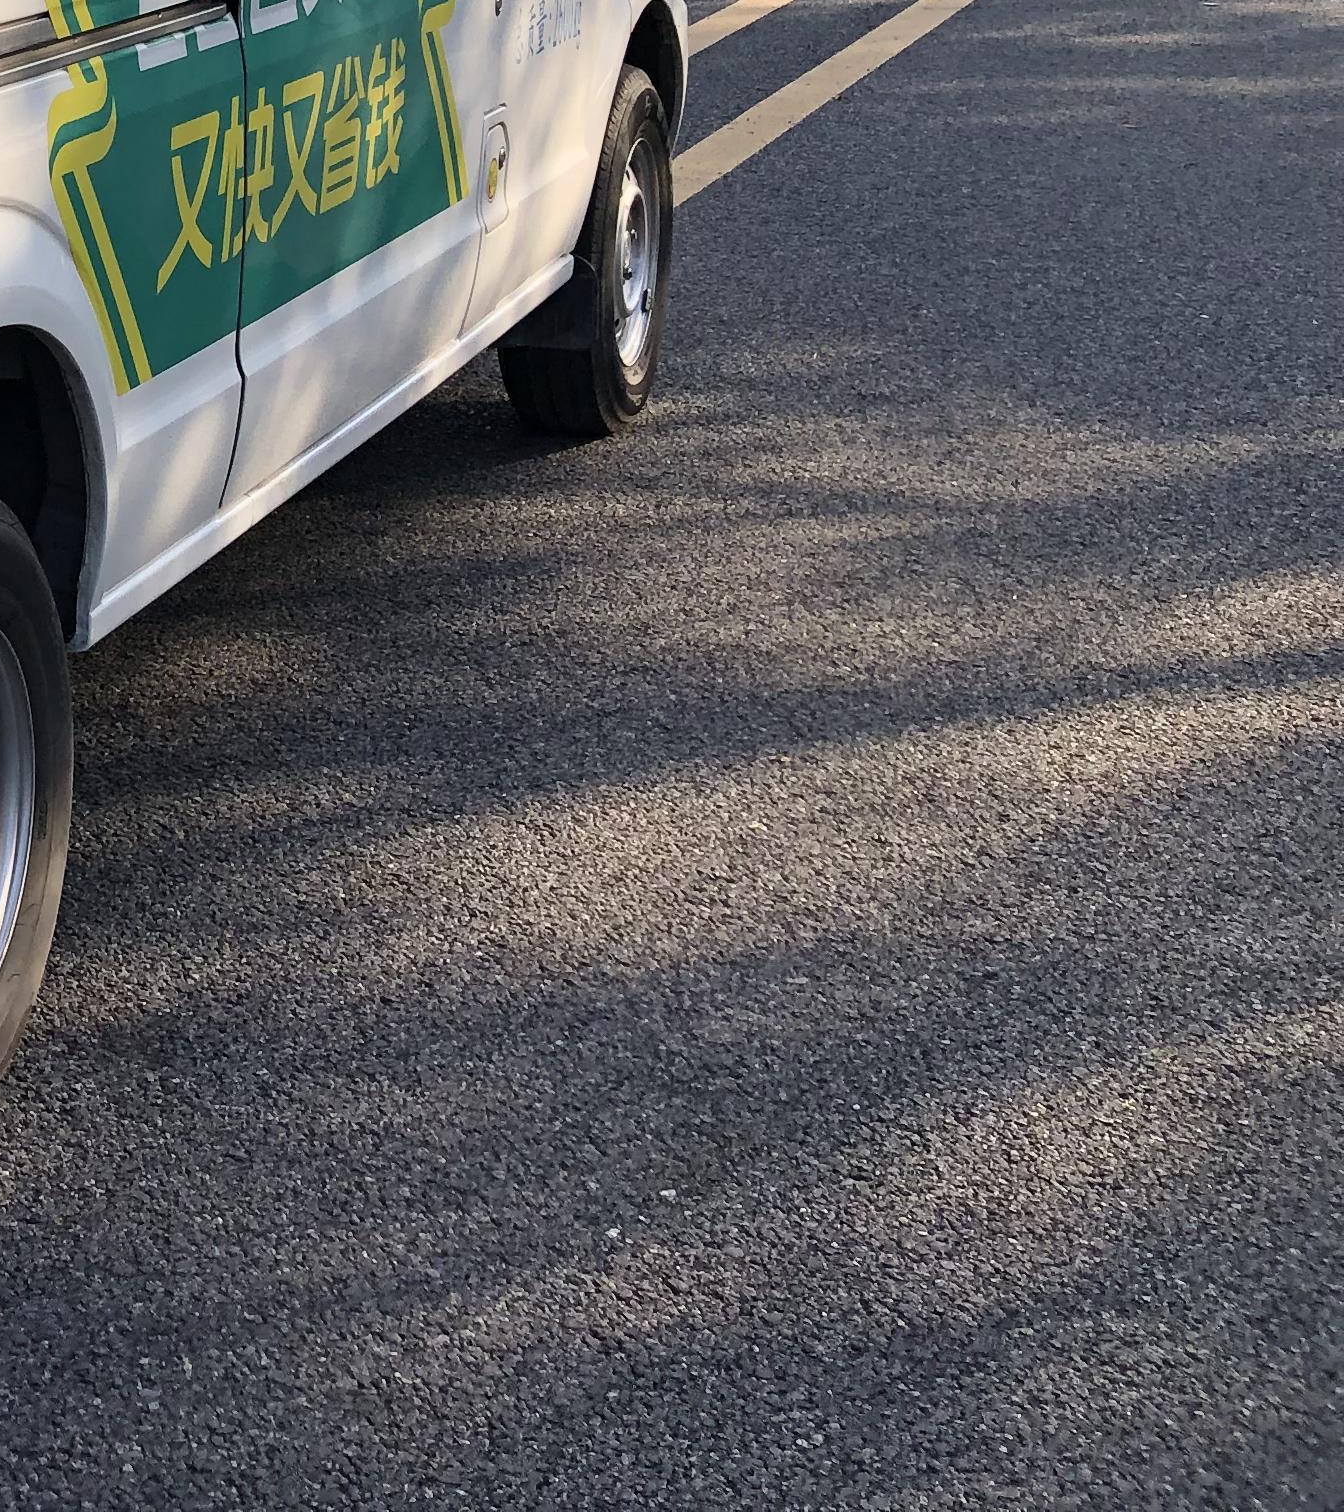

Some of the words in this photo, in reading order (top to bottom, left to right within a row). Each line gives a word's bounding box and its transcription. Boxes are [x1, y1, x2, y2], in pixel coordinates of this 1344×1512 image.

[156, 36, 406, 294] 又快又省钱
